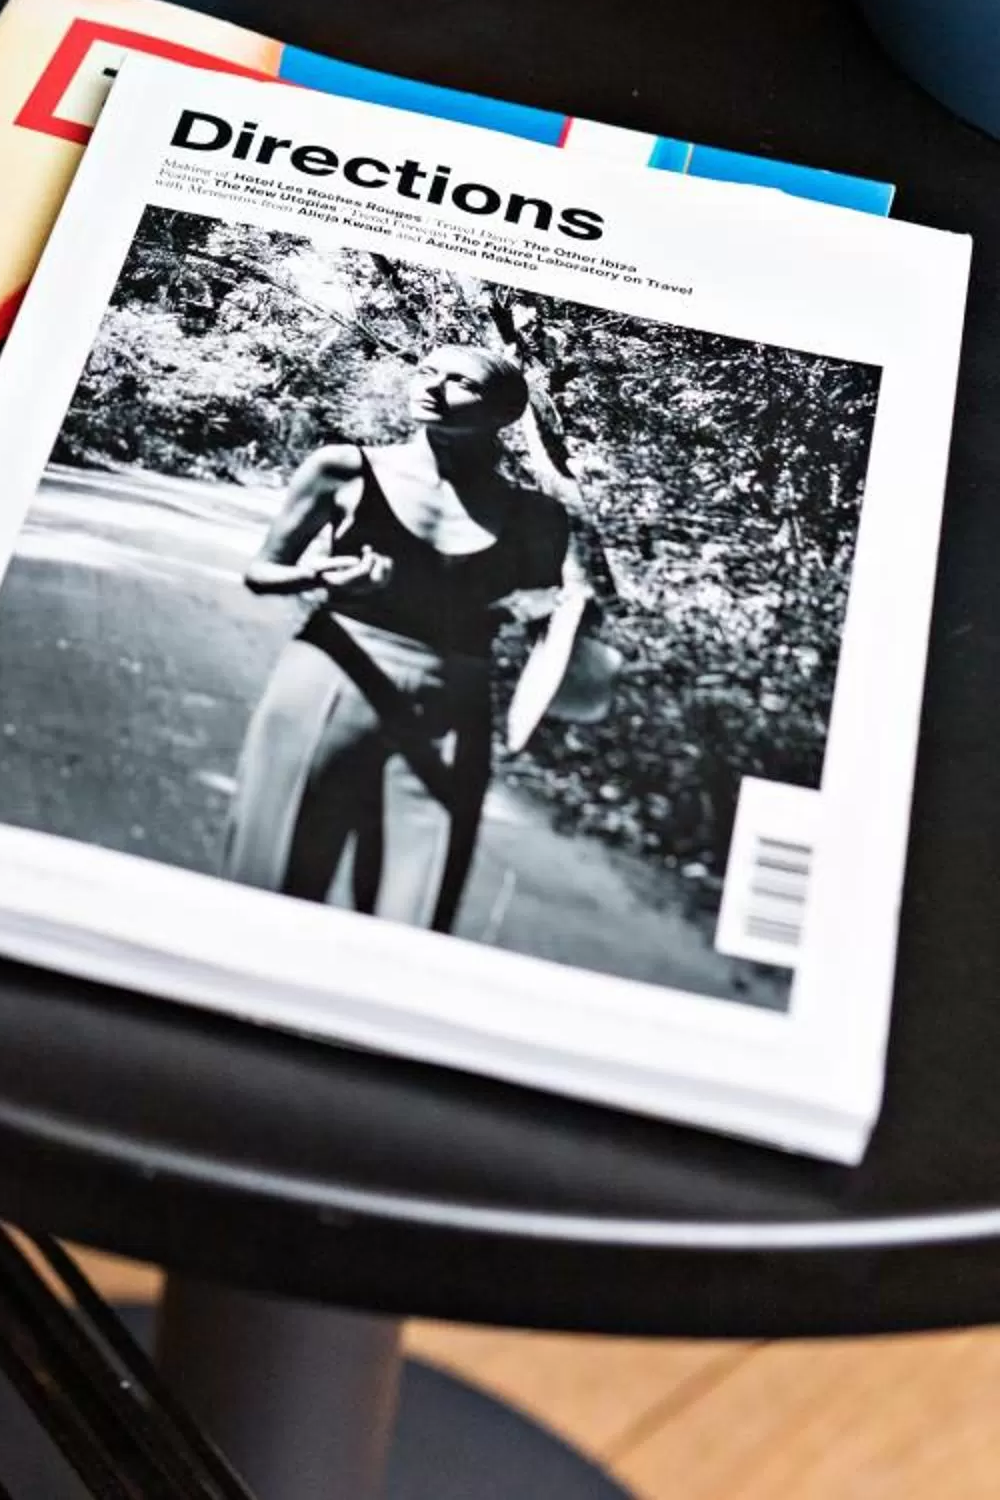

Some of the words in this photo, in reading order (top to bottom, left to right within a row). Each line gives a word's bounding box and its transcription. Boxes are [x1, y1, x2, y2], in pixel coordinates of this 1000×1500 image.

[170, 109, 605, 242] Directions
[277, 181, 304, 195] Les
[307, 187, 363, 207] Roches
[365, 201, 423, 223] Rouges
[522, 238, 551, 254] The
[553, 247, 598, 266] Other
[600, 256, 638, 274] Ibiza
[214, 177, 242, 192] The
[244, 184, 278, 199] New
[279, 191, 338, 213] Utopias
[453, 232, 482, 247] The
[483, 240, 534, 260] Future
[536, 252, 620, 282] Laboratory
[623, 274, 643, 285] on
[646, 276, 694, 296] Travel
[297, 206, 340, 226] Alicja
[342, 216, 393, 237] Kwade
[425, 236, 478, 258] Azuma
[481, 250, 539, 272] Makoto
